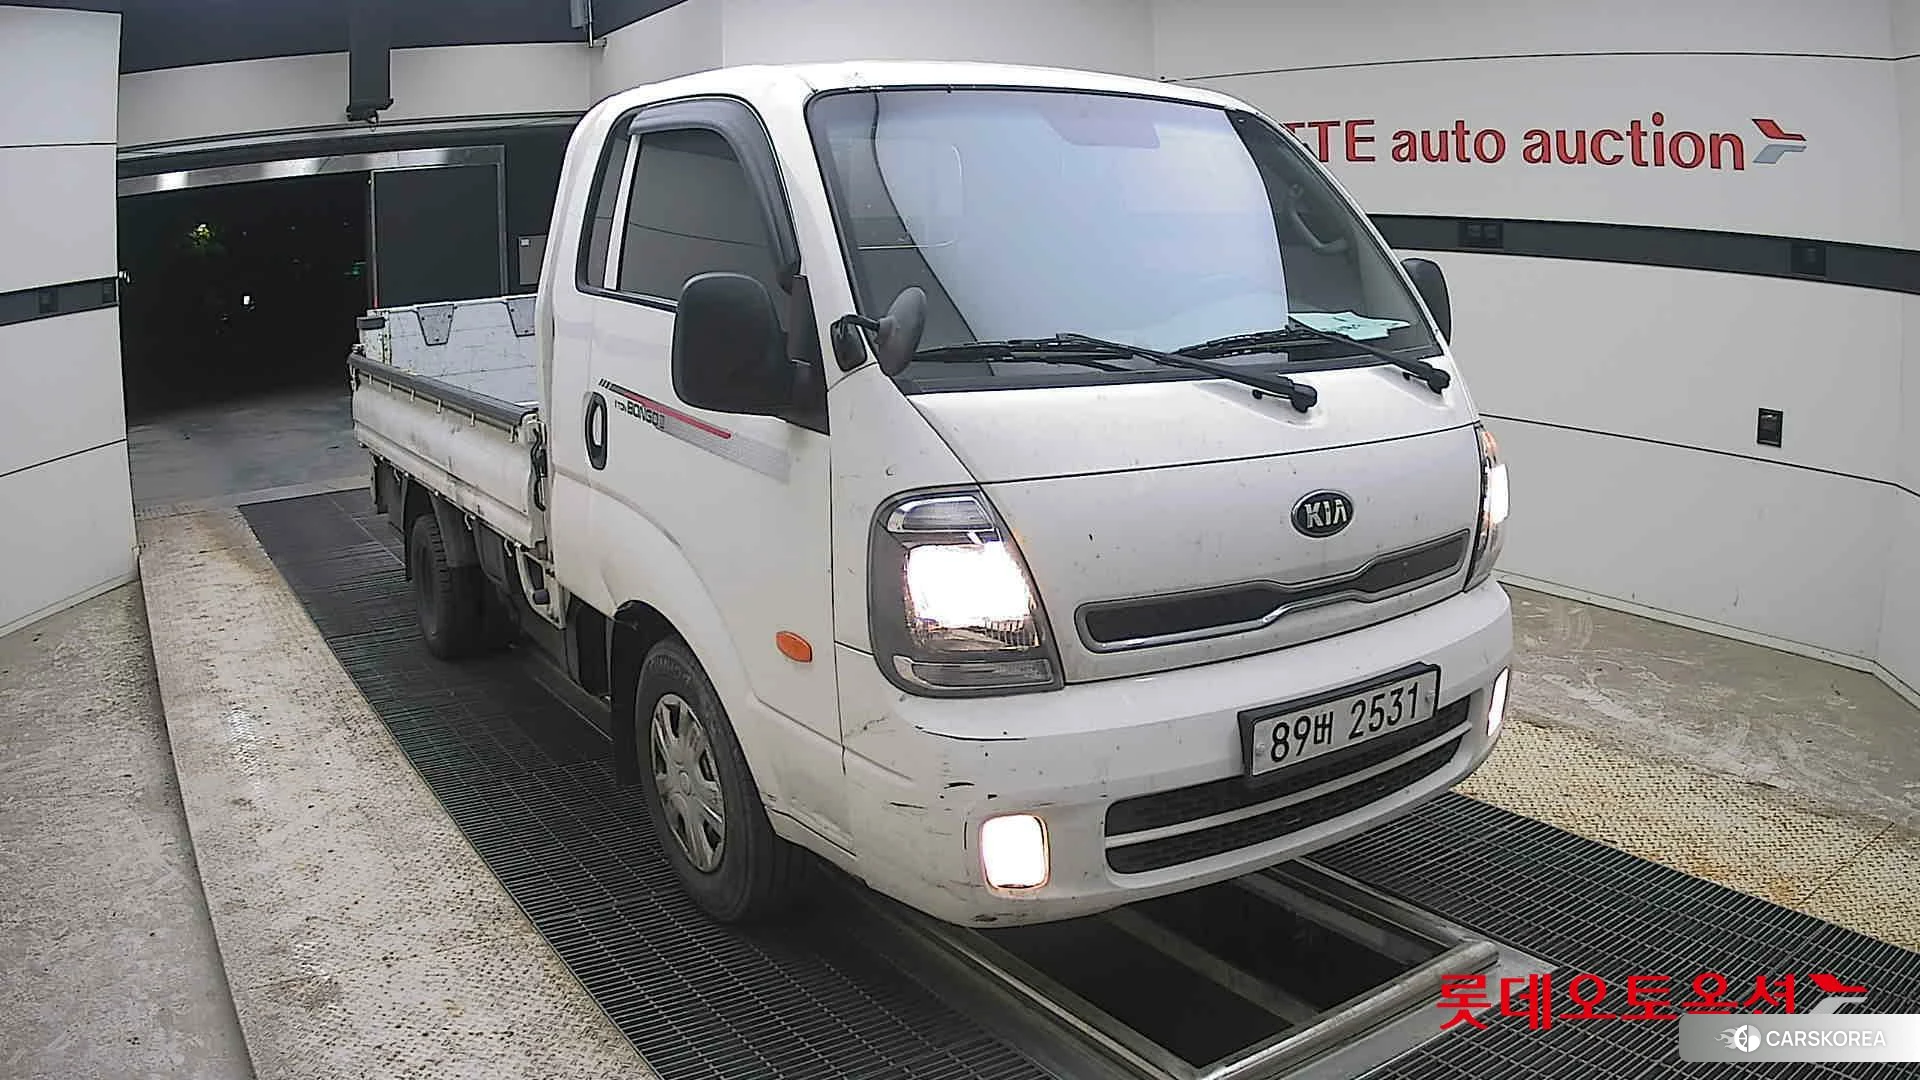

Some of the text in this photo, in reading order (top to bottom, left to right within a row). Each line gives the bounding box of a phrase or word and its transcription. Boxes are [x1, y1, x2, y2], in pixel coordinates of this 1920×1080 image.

[1391, 120, 1506, 162] auto
[1522, 112, 1744, 171] auction
[1304, 499, 1347, 528] KIA
[1271, 682, 1418, 762] 89버 2531
